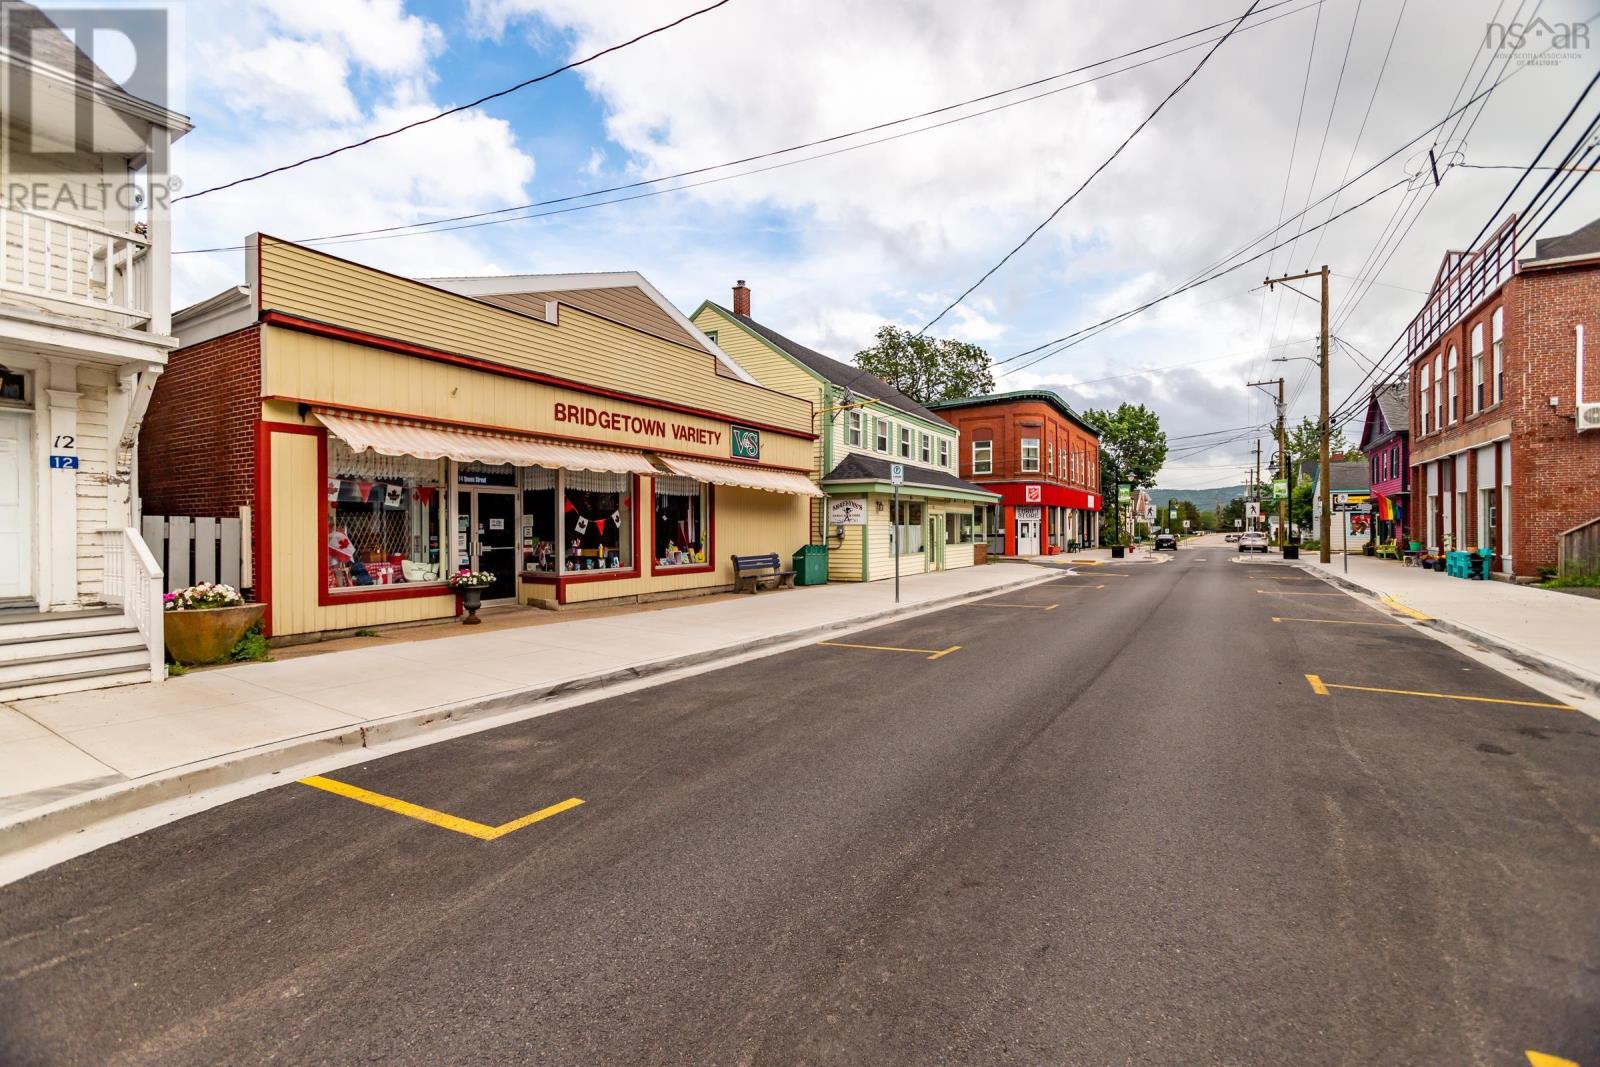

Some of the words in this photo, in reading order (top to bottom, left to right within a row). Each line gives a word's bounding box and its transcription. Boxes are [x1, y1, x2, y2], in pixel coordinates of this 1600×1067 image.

[554, 402, 666, 438] BRIDGETOWN
[672, 423, 722, 446] VARIETY
[54, 435, 74, 449] 12
[54, 456, 73, 469] 12
